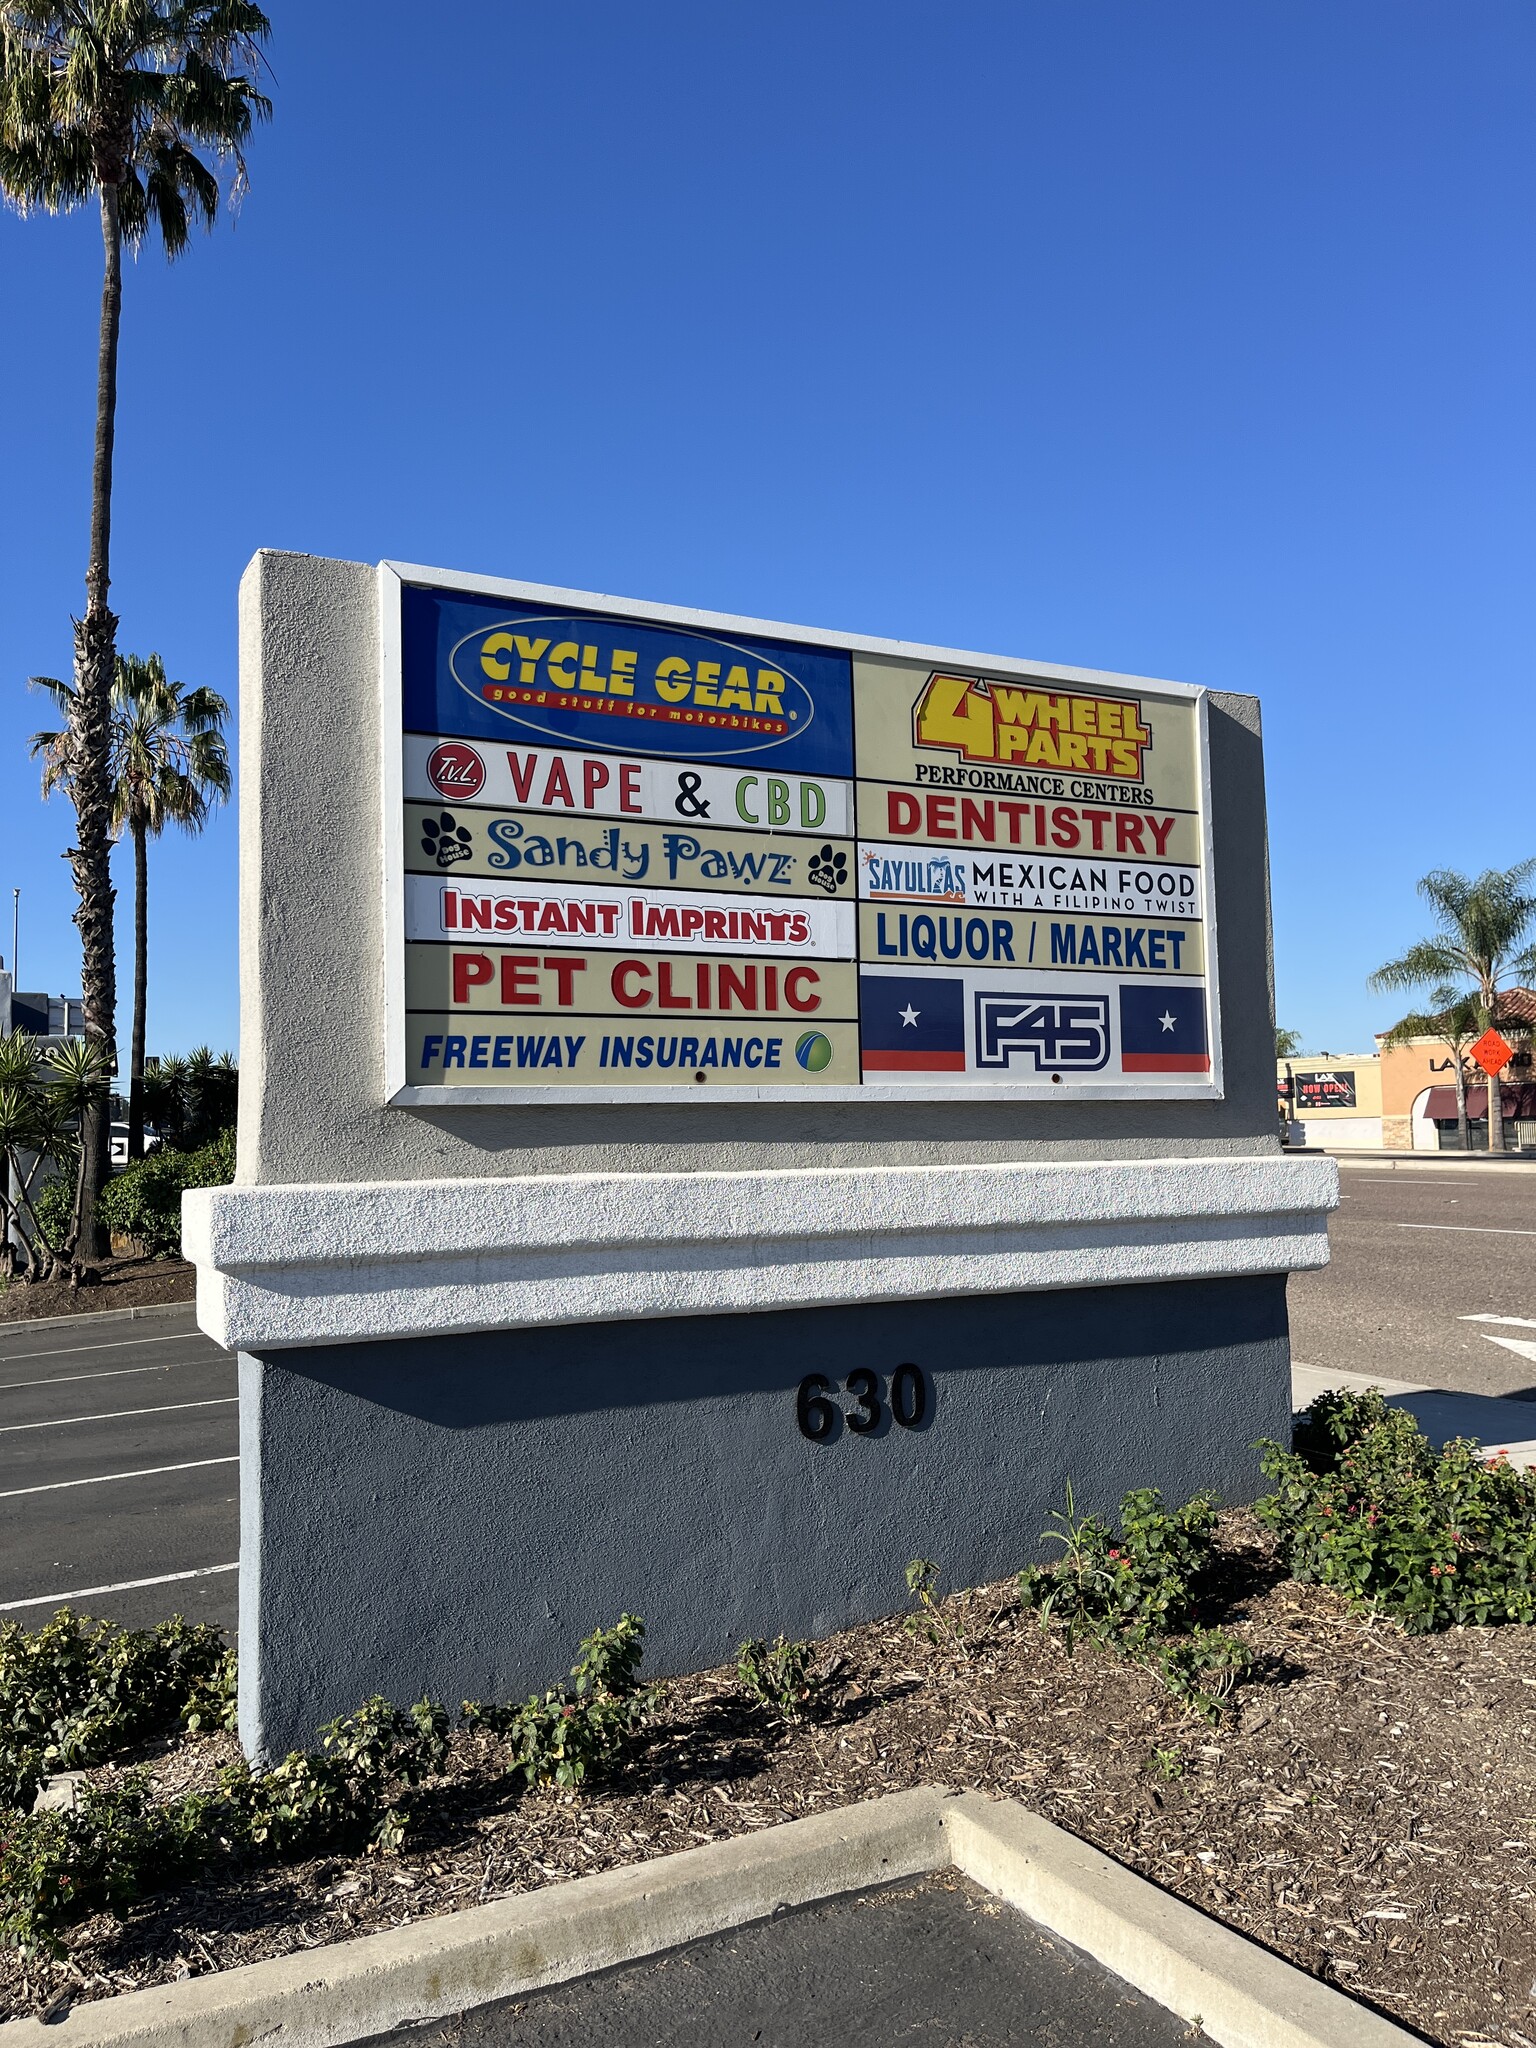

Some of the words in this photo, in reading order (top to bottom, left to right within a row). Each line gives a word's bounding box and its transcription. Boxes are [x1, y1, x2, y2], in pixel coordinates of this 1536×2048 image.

[480, 632, 638, 696] CYCLE
[654, 656, 786, 715] GEAR
[493, 689, 547, 703] good
[560, 697, 615, 712] stuff
[626, 702, 657, 717] for
[669, 710, 783, 732] motorbikes
[917, 676, 995, 758] 4
[992, 687, 1149, 742] WHEEL
[997, 723, 1139, 776] PARTS
[506, 751, 643, 814] VAPE
[674, 771, 711, 819] &
[735, 775, 827, 828] CBD
[915, 763, 1065, 797] PERFORMANCE
[1071, 781, 1154, 805] CENTERS
[887, 790, 1176, 857] DENTISTRY
[439, 848, 470, 864] House
[441, 843, 460, 855] Dog
[487, 819, 649, 880] Sandy
[662, 833, 797, 885] Pawz
[811, 873, 835, 890] House
[818, 870, 833, 883] Dog
[972, 861, 1107, 892] MEXICAN
[1119, 870, 1195, 897] FOOD
[444, 891, 619, 934] INSTANT
[632, 900, 809, 943] IMPRINTS
[974, 890, 1023, 906] WITH
[1034, 894, 1043, 907] A
[1054, 894, 1135, 911] FILIPINO
[1144, 899, 1196, 915] TWIST
[876, 912, 1015, 962] LIQUOR
[1051, 923, 1186, 970] MARKET
[452, 952, 587, 1006] PET
[610, 959, 821, 1012] CLINIC
[421, 1034, 586, 1069] FREEWAY
[600, 1035, 783, 1069] INSURANCE
[977, 995, 1107, 1067] F45
[1483, 1040, 1501, 1048] ROAD
[1314, 1072, 1336, 1083] LAX
[1482, 1057, 1503, 1066] AHEAD
[796, 1362, 926, 1441] 630
